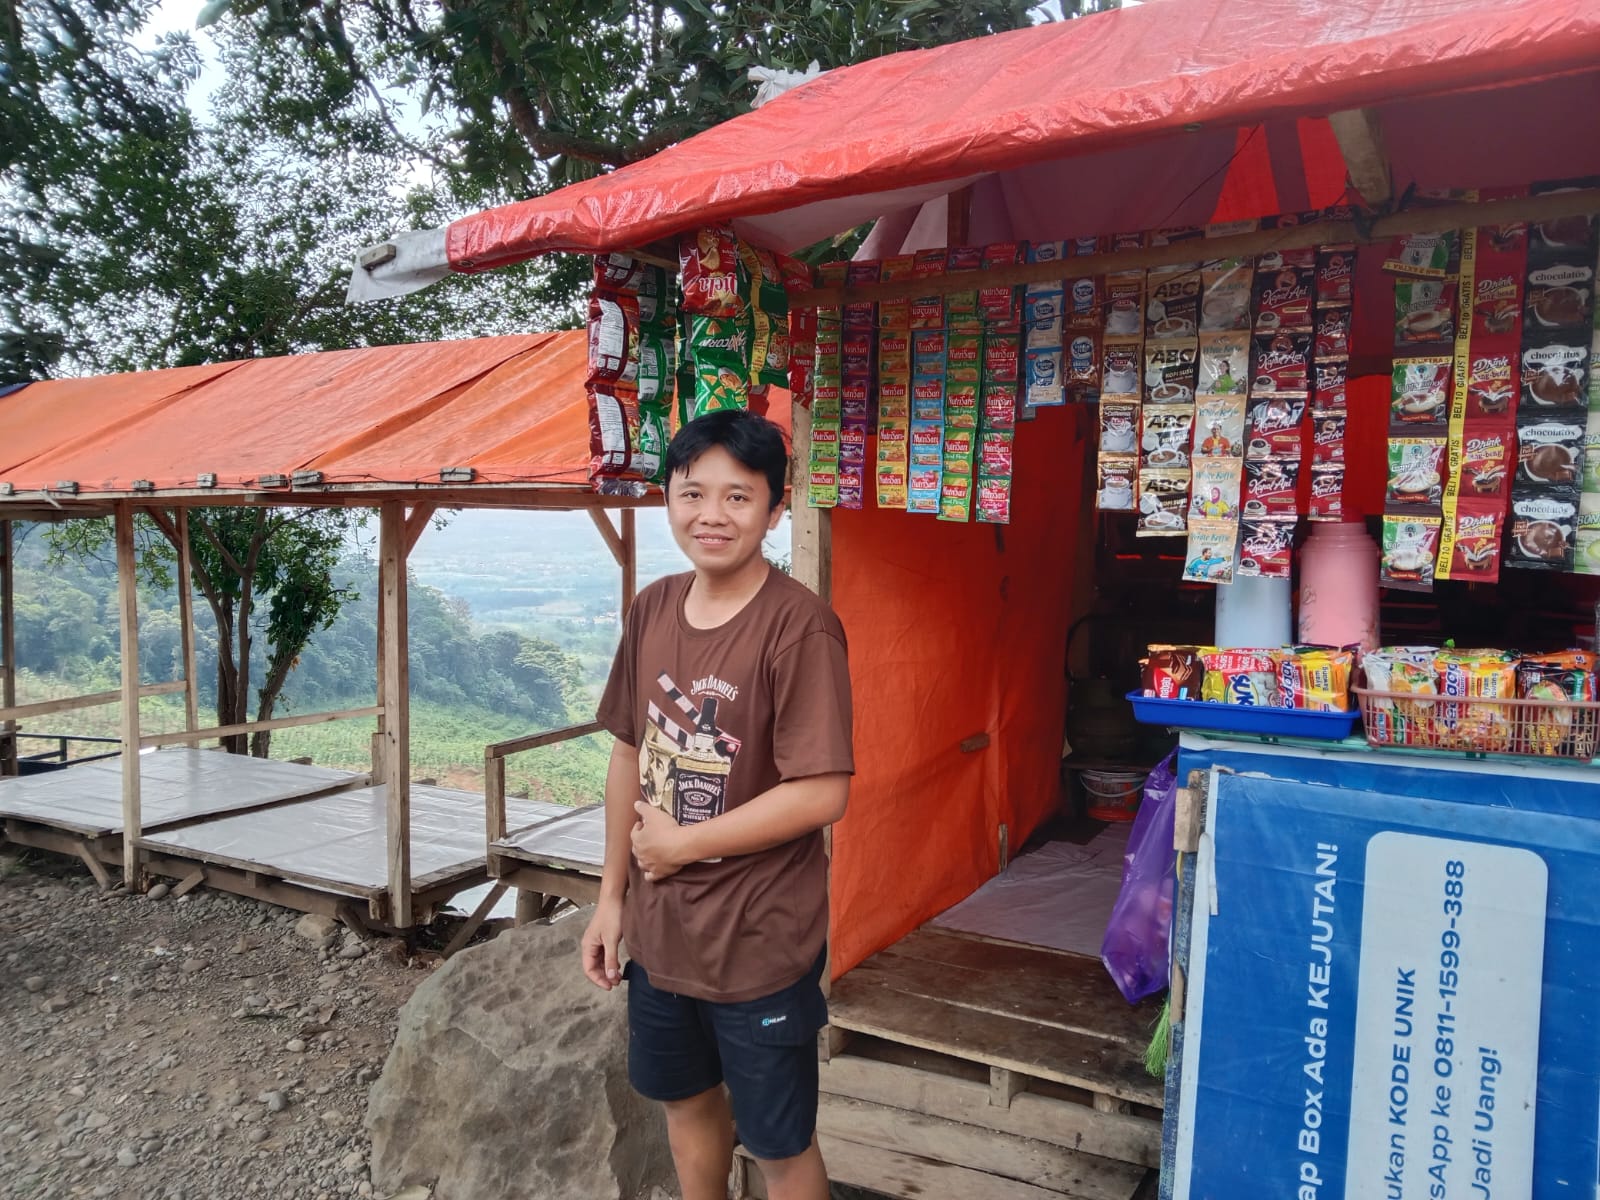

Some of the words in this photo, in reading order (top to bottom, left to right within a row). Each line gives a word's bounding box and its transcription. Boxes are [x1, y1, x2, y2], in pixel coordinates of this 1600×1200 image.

[1535, 269, 1586, 281] chocolatos
[1154, 281, 1199, 298] ABC
[1478, 275, 1514, 293] Drink
[1263, 289, 1289, 305] Kapal
[1289, 285, 1309, 300] Api
[1461, 281, 1471, 307] GRATIS
[1151, 349, 1194, 364] ABC
[1473, 356, 1509, 371] Drink
[1530, 351, 1580, 360] chocatos
[1456, 361, 1465, 388] GRATIS
[1456, 391, 1464, 400] 10
[1453, 401, 1463, 419] BELI
[1148, 415, 1192, 428] ABC
[913, 433, 939, 444] NutriSari
[1525, 427, 1576, 436] chocolatos
[945, 441, 968, 452] NutriSari
[984, 444, 1010, 454] NutriSari
[1467, 436, 1502, 452] Drink
[1450, 439, 1460, 467] GRATIS
[811, 474, 833, 484] NutriSari
[912, 477, 937, 489] NutriSari
[1449, 470, 1458, 480] 10
[942, 486, 966, 497] NutriSari
[1145, 479, 1188, 492] ABC
[1249, 480, 1273, 496] Kapal
[1273, 478, 1292, 491] Api
[1330, 483, 1342, 494] Api
[1446, 481, 1458, 497] BELI
[1443, 515, 1454, 543] GRATIS
[1460, 514, 1496, 530] Drink
[1441, 547, 1450, 556] 10
[1438, 557, 1449, 574] BELI
[690, 678, 708, 696] JACK
[678, 780, 694, 792] JACK
[1307, 842, 1339, 1010] KEJUTAN!
[1434, 860, 1465, 1078] 0811-1599-388
[1393, 967, 1417, 1038] UNIK
[1301, 1018, 1329, 1086] Ada
[1388, 1044, 1412, 1127] KODE
[1473, 1046, 1502, 1133] Uang!
[1430, 1085, 1452, 1118] ke
[1298, 1089, 1324, 1155] Box
[1383, 1132, 1407, 1200] ukan
[1428, 1125, 1453, 1200] sApp
[1470, 1138, 1493, 1200] Jadi
